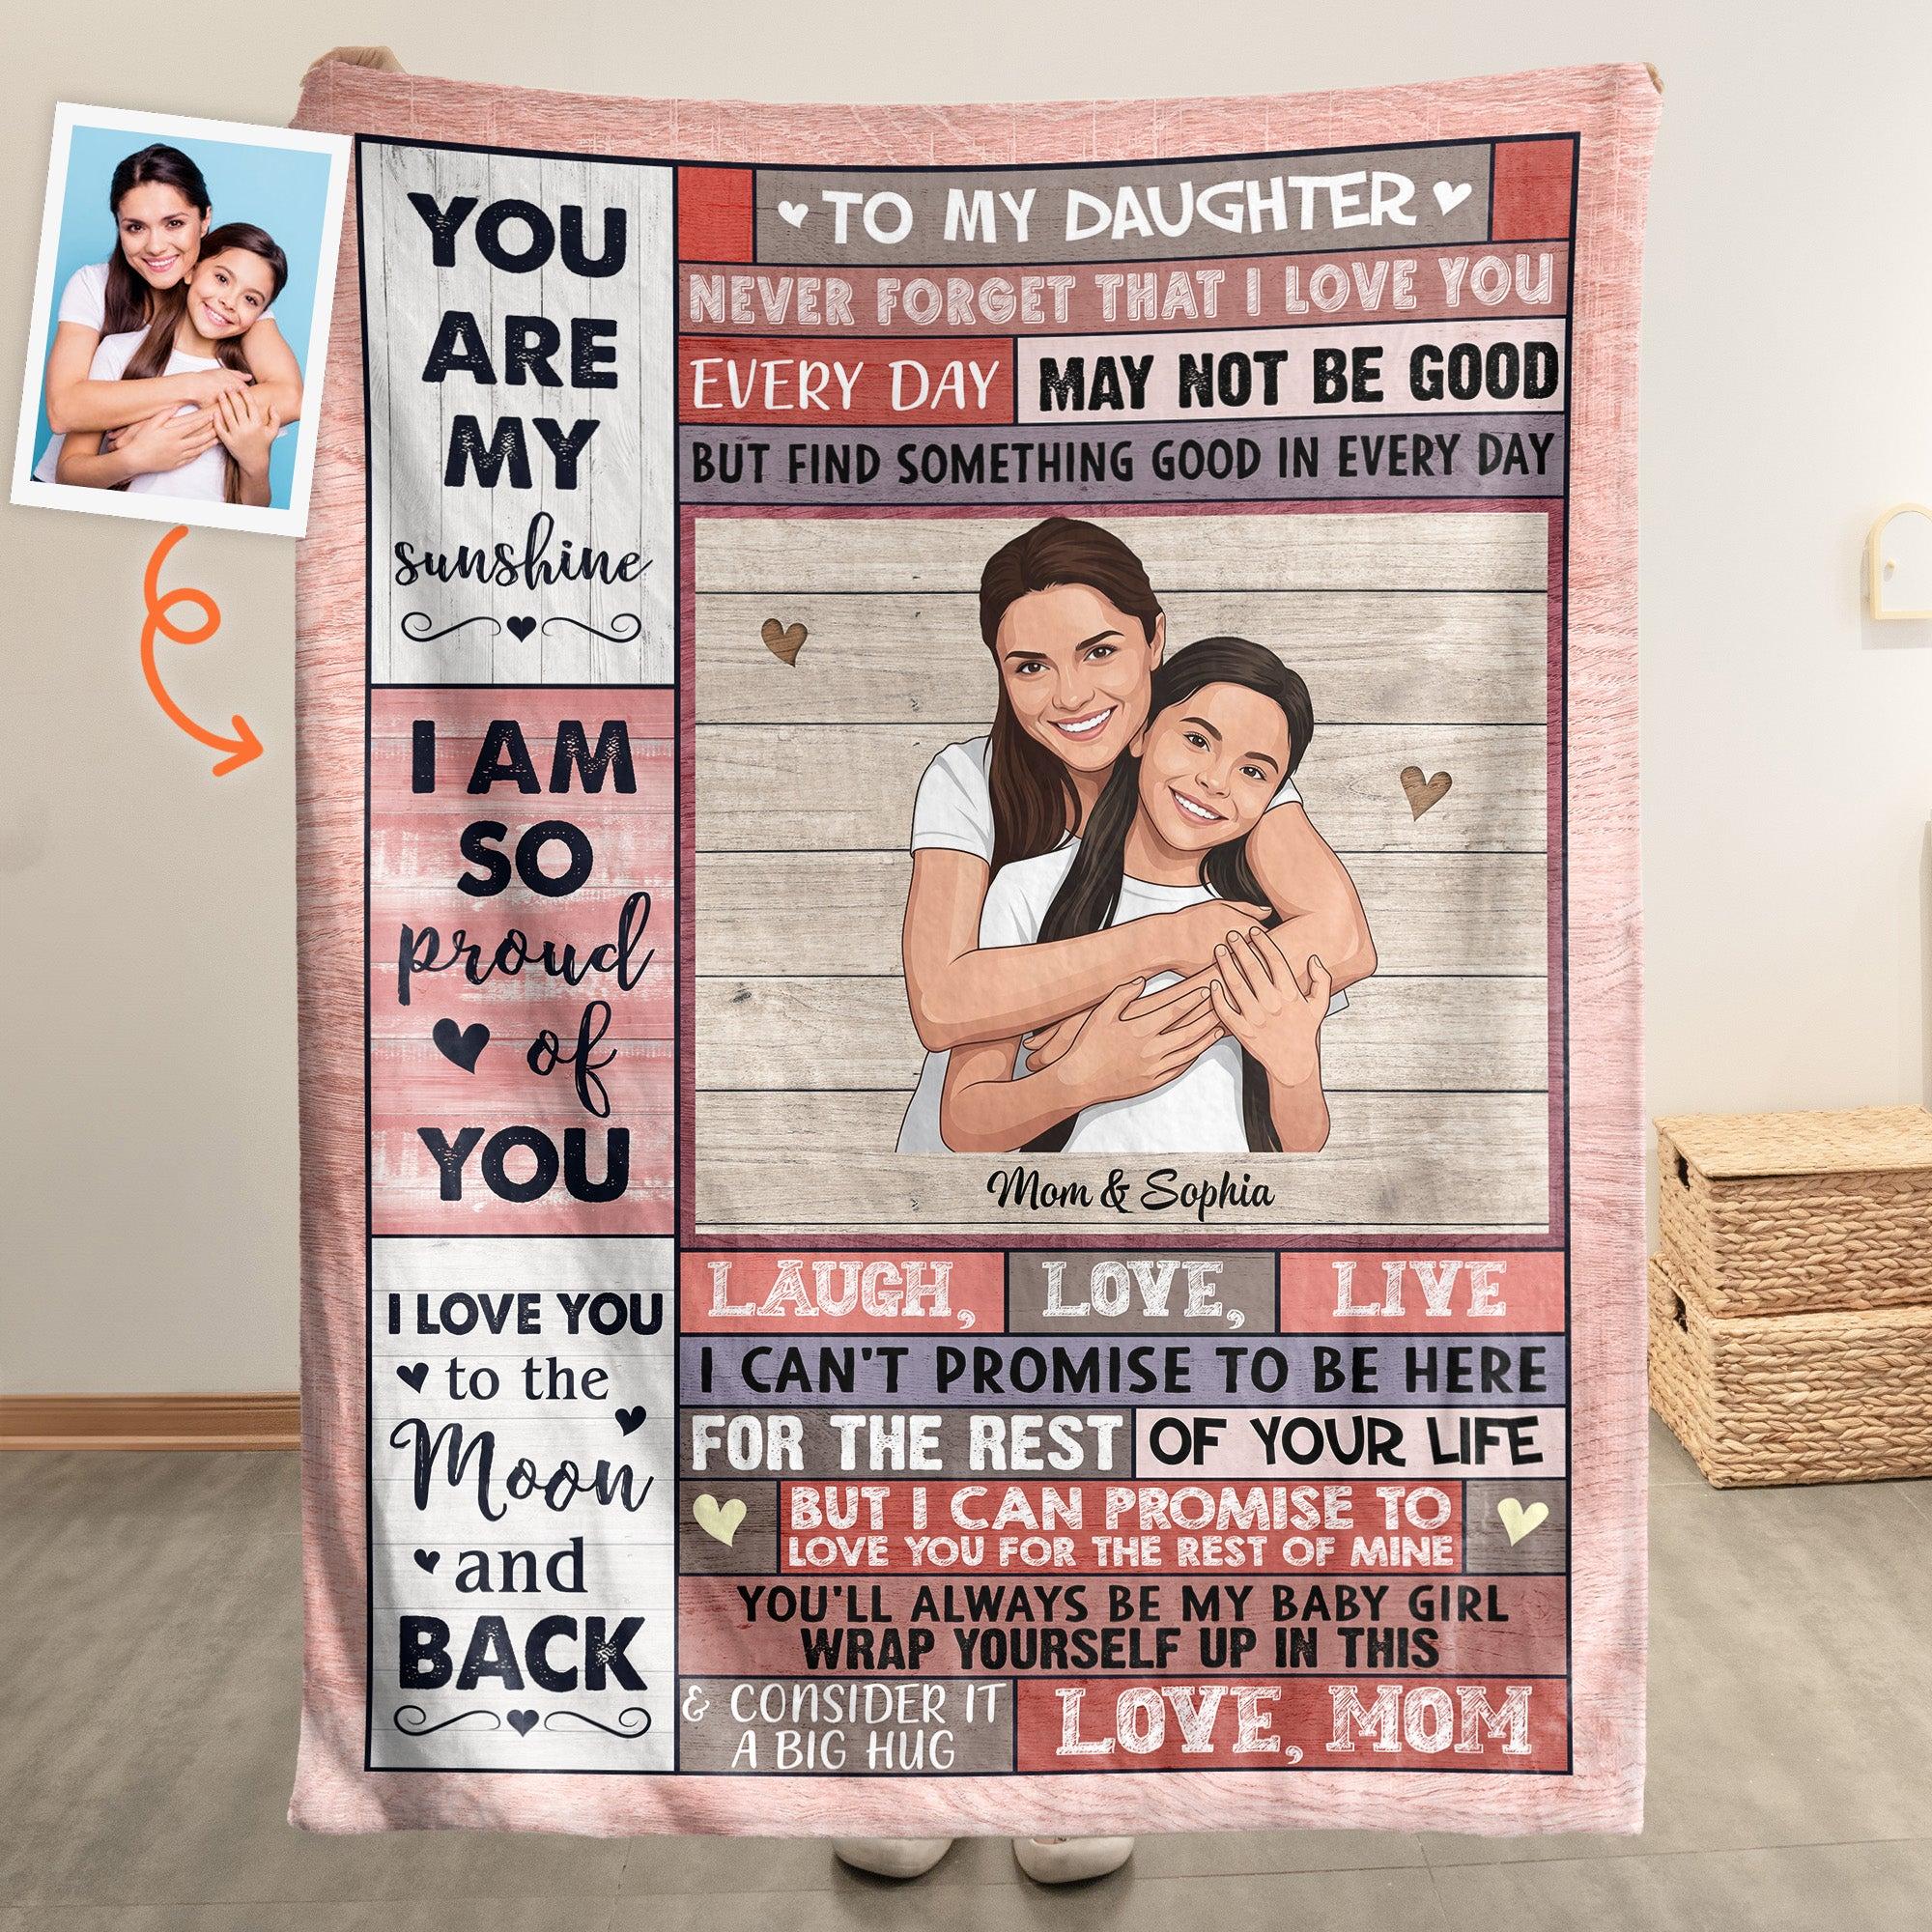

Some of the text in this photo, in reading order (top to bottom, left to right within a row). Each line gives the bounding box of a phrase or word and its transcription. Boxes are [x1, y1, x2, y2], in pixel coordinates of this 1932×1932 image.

[407, 191, 628, 278] YOU
[821, 170, 1417, 245] TO MY DAUGHTER
[689, 252, 1553, 327] NEVER FORGET THAT I LOVE YOU
[421, 309, 619, 389] ARE
[689, 356, 1000, 412] EVERY DAY
[1038, 340, 1560, 412] MAY NOT BE GOOD
[443, 414, 601, 491] MY
[692, 432, 1555, 484] BUT FIND SOMETHING GOOD IN EVERY DAY
[393, 511, 654, 591] sunshine
[412, 719, 638, 796] I AM
[456, 819, 594, 898] SO
[396, 890, 656, 1007] proud
[526, 999, 618, 1119] of
[416, 1124, 631, 1204] YOU
[985, 1165, 1276, 1223] Mom & Sophia
[387, 1292, 663, 1336] I LOVE YOU
[706, 1259, 977, 1330] LAUGH,
[1041, 1259, 1245, 1330] LOVE,
[1331, 1260, 1508, 1319] LIVE
[444, 1356, 610, 1401] to the
[700, 1345, 1548, 1395] I CAN'T PROMISE TO BE HERE
[388, 1417, 655, 1522] Moon
[691, 1413, 1123, 1472] FOR THE REST
[1149, 1414, 1545, 1468] OF YOUR LIFE
[790, 1485, 1451, 1531] BUT I CAN PROMISE TO
[454, 1536, 588, 1595] and
[788, 1534, 1454, 1569] LOVE YOU FOR THE REST OF MINE
[736, 1583, 1510, 1624] YOU'LL ALWAYS BE MY BABY GIRL
[398, 1614, 649, 1692] BACK
[800, 1627, 1440, 1671] WRAP YOURSELF UP IN THIS
[681, 1682, 1008, 1725] & CONSIDER IT
[1055, 1684, 1533, 1766] LOVE, MOM
[730, 1728, 956, 1772] A BIG HUG
